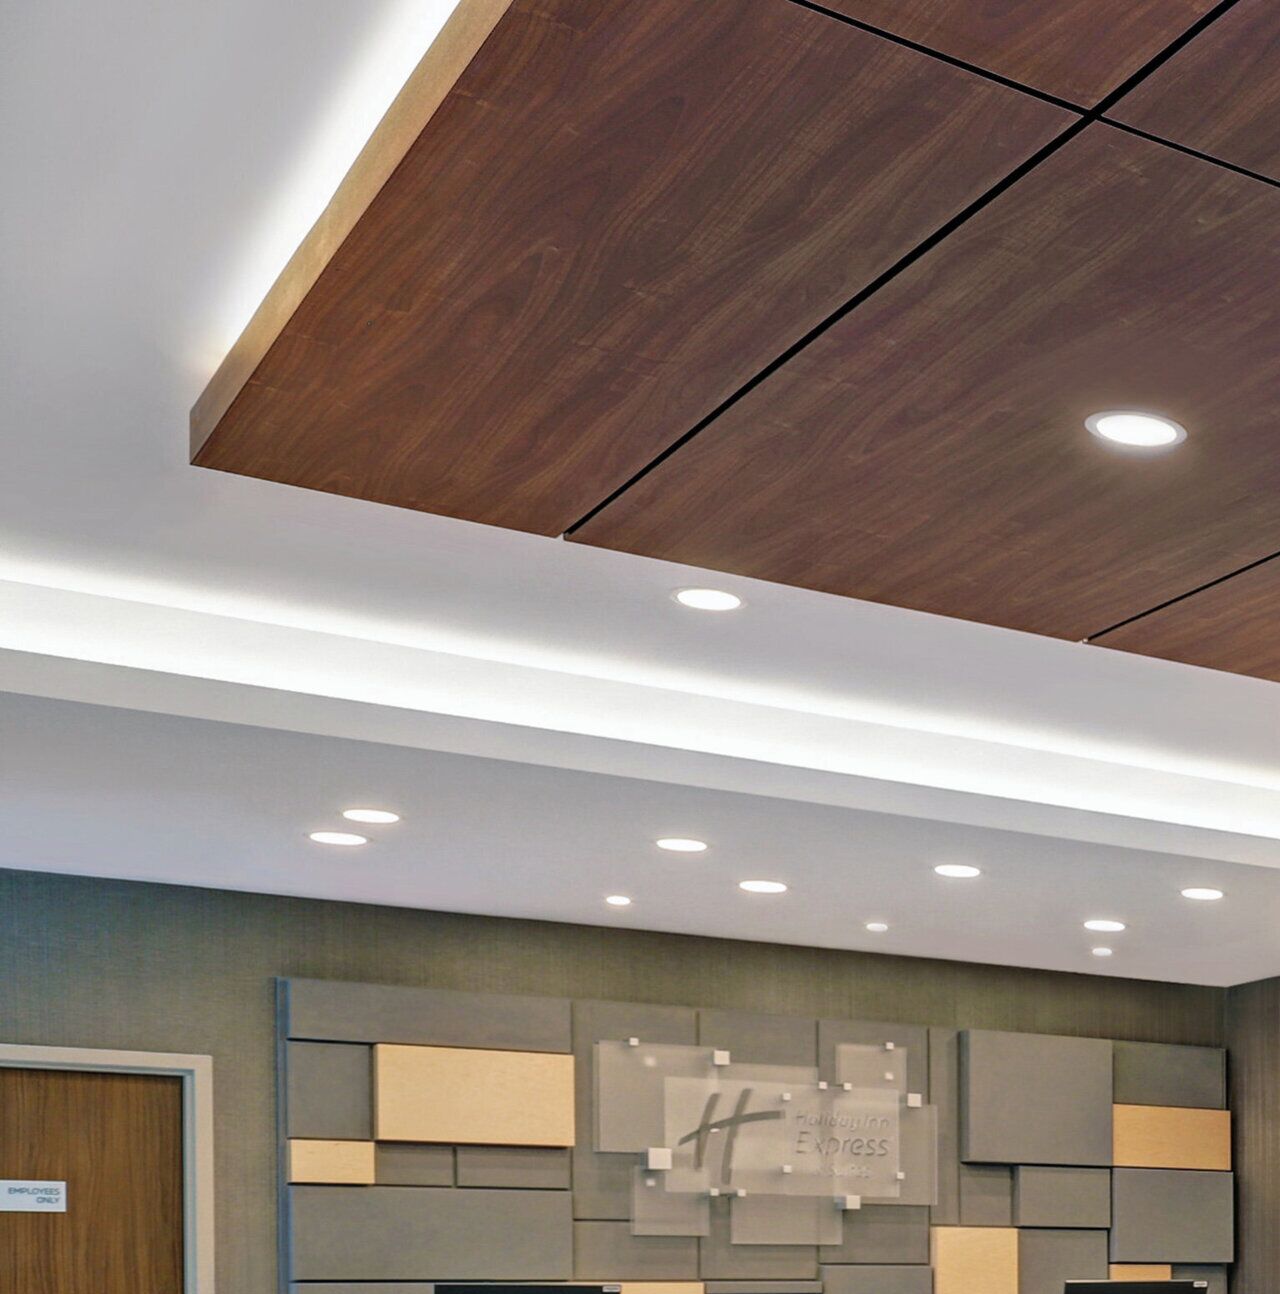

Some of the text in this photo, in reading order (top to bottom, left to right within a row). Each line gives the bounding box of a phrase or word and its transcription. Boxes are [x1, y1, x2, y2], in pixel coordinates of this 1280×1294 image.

[796, 1131, 889, 1158] Express
[8, 1187, 60, 1196] EMPLOYEES
[36, 1196, 60, 1204] ONLY
